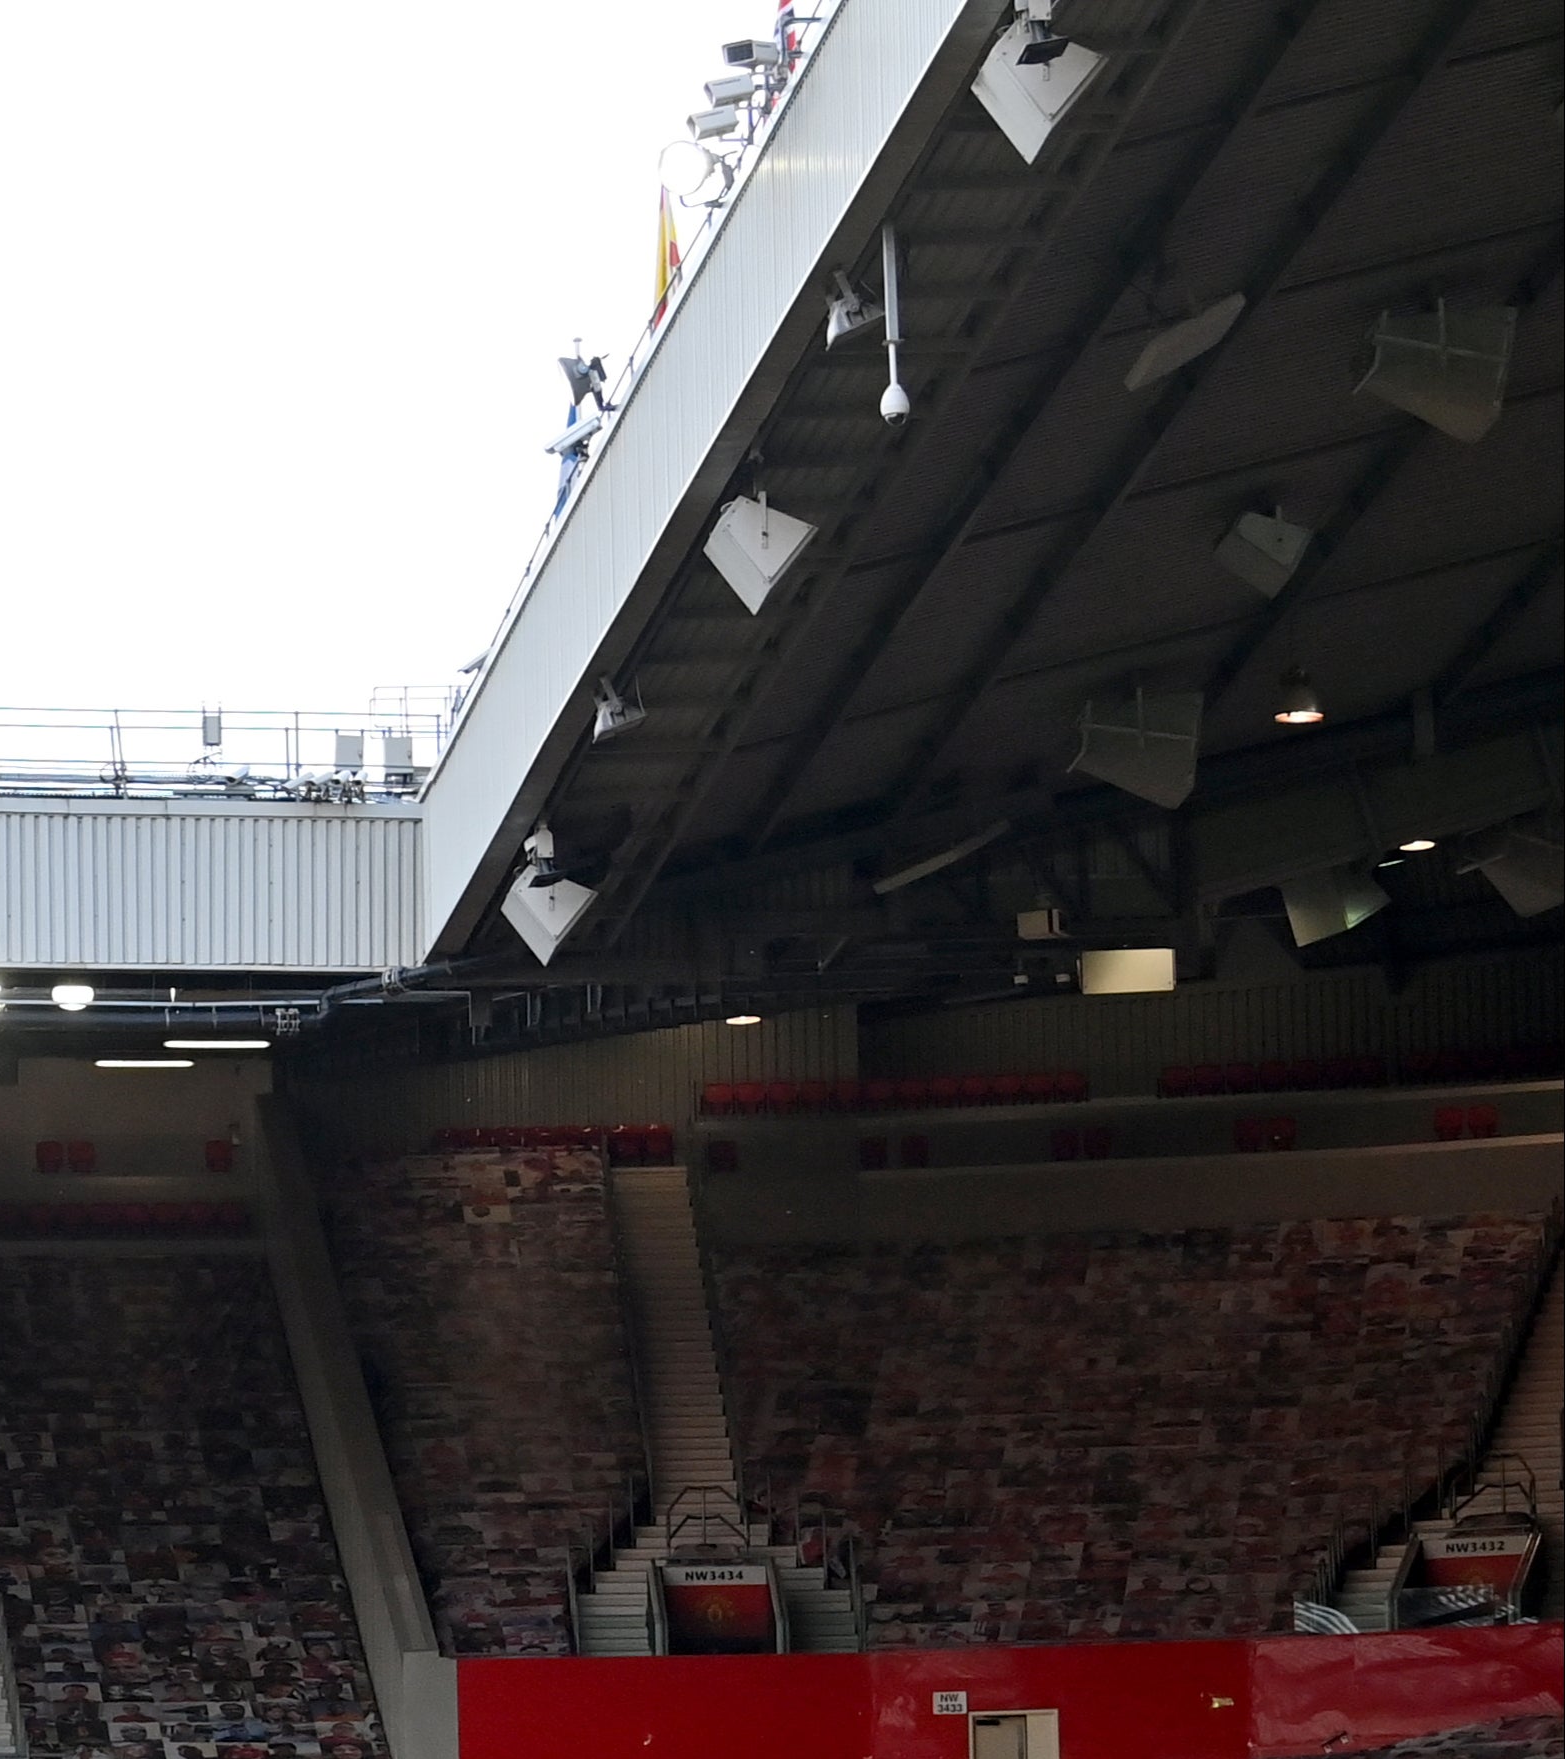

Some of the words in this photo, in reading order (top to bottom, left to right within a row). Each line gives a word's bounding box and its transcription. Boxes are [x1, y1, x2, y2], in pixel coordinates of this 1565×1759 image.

[1445, 1540, 1505, 1554] NW3432
[685, 1570, 744, 1582] NW3434
[940, 1694, 959, 1703] NW
